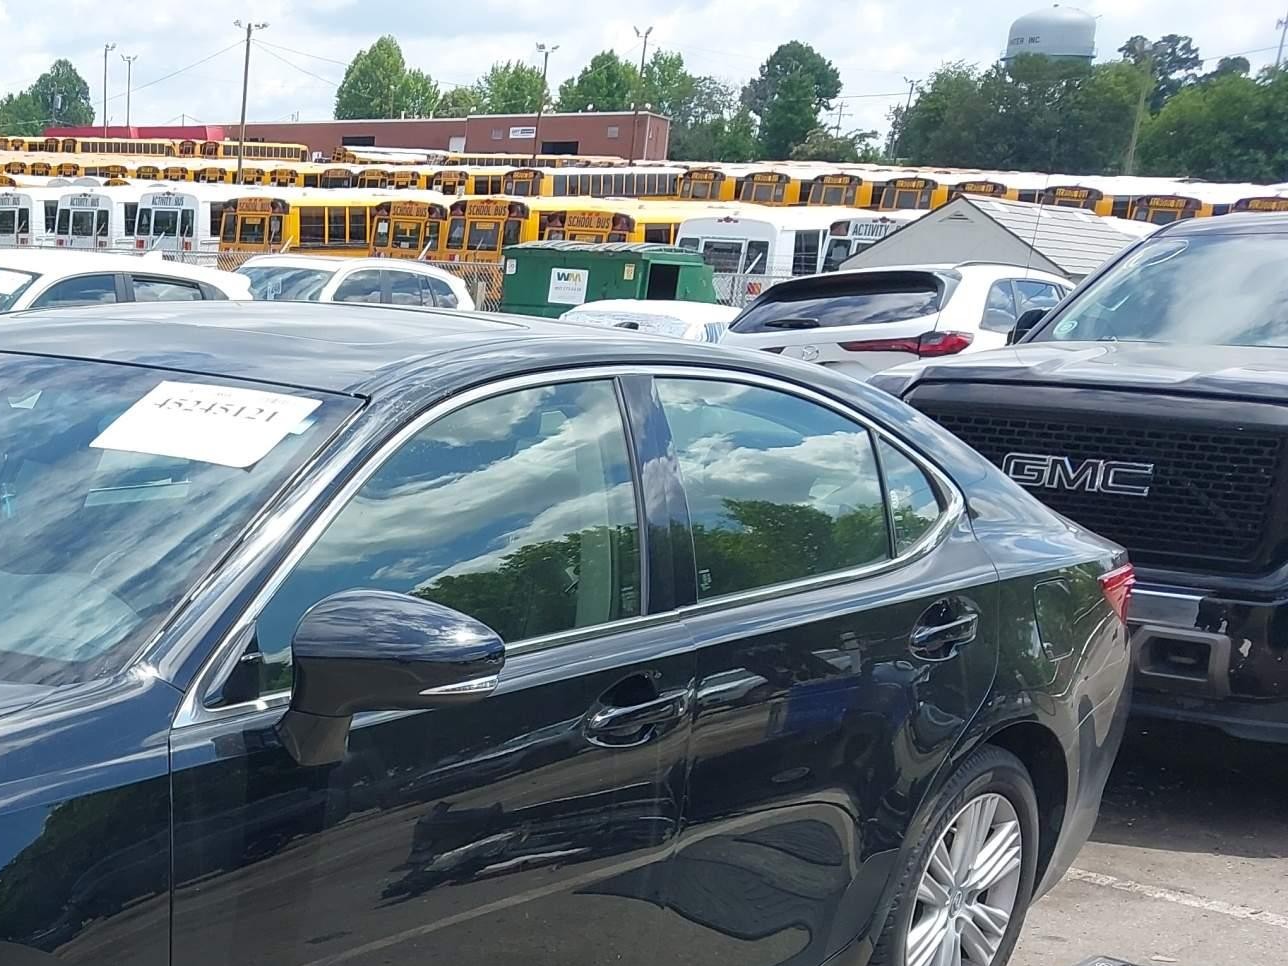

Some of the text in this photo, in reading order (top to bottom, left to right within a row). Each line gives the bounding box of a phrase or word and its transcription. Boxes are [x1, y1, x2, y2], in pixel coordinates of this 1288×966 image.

[152, 196, 184, 206] ACTIVITY BUS
[393, 205, 427, 217] SCHOOL BUS
[468, 205, 507, 216] SCHOOL BUS
[567, 215, 610, 228] SCHOOL BUS
[852, 223, 890, 237] ACTIVITY
[556, 271, 582, 282] WM
[153, 398, 280, 423] 45245121
[1002, 452, 1154, 497] GMC
